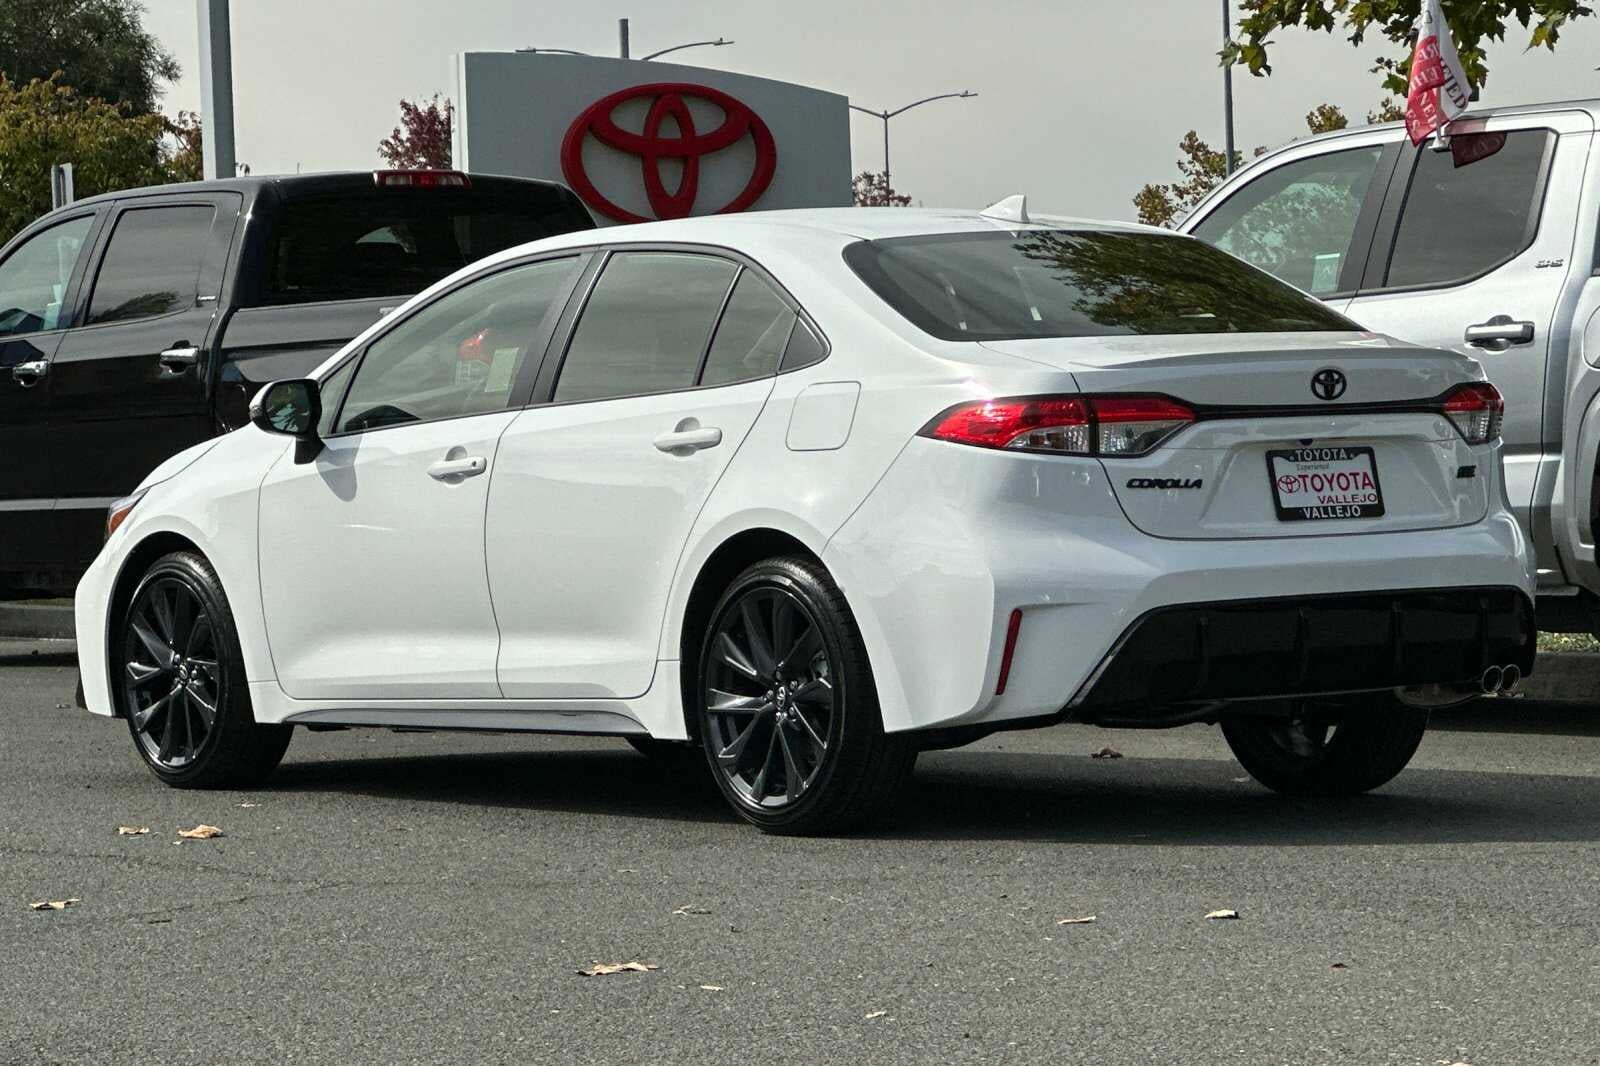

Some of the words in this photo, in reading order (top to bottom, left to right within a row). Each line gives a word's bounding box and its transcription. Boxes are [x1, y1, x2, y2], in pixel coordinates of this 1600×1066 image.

[1295, 448, 1347, 460] TOYOTA
[1126, 478, 1203, 489] COROLLA
[1298, 472, 1375, 493] TOYOTA
[1317, 493, 1377, 504] VALLEJO
[1303, 505, 1361, 518] VALLEJO
